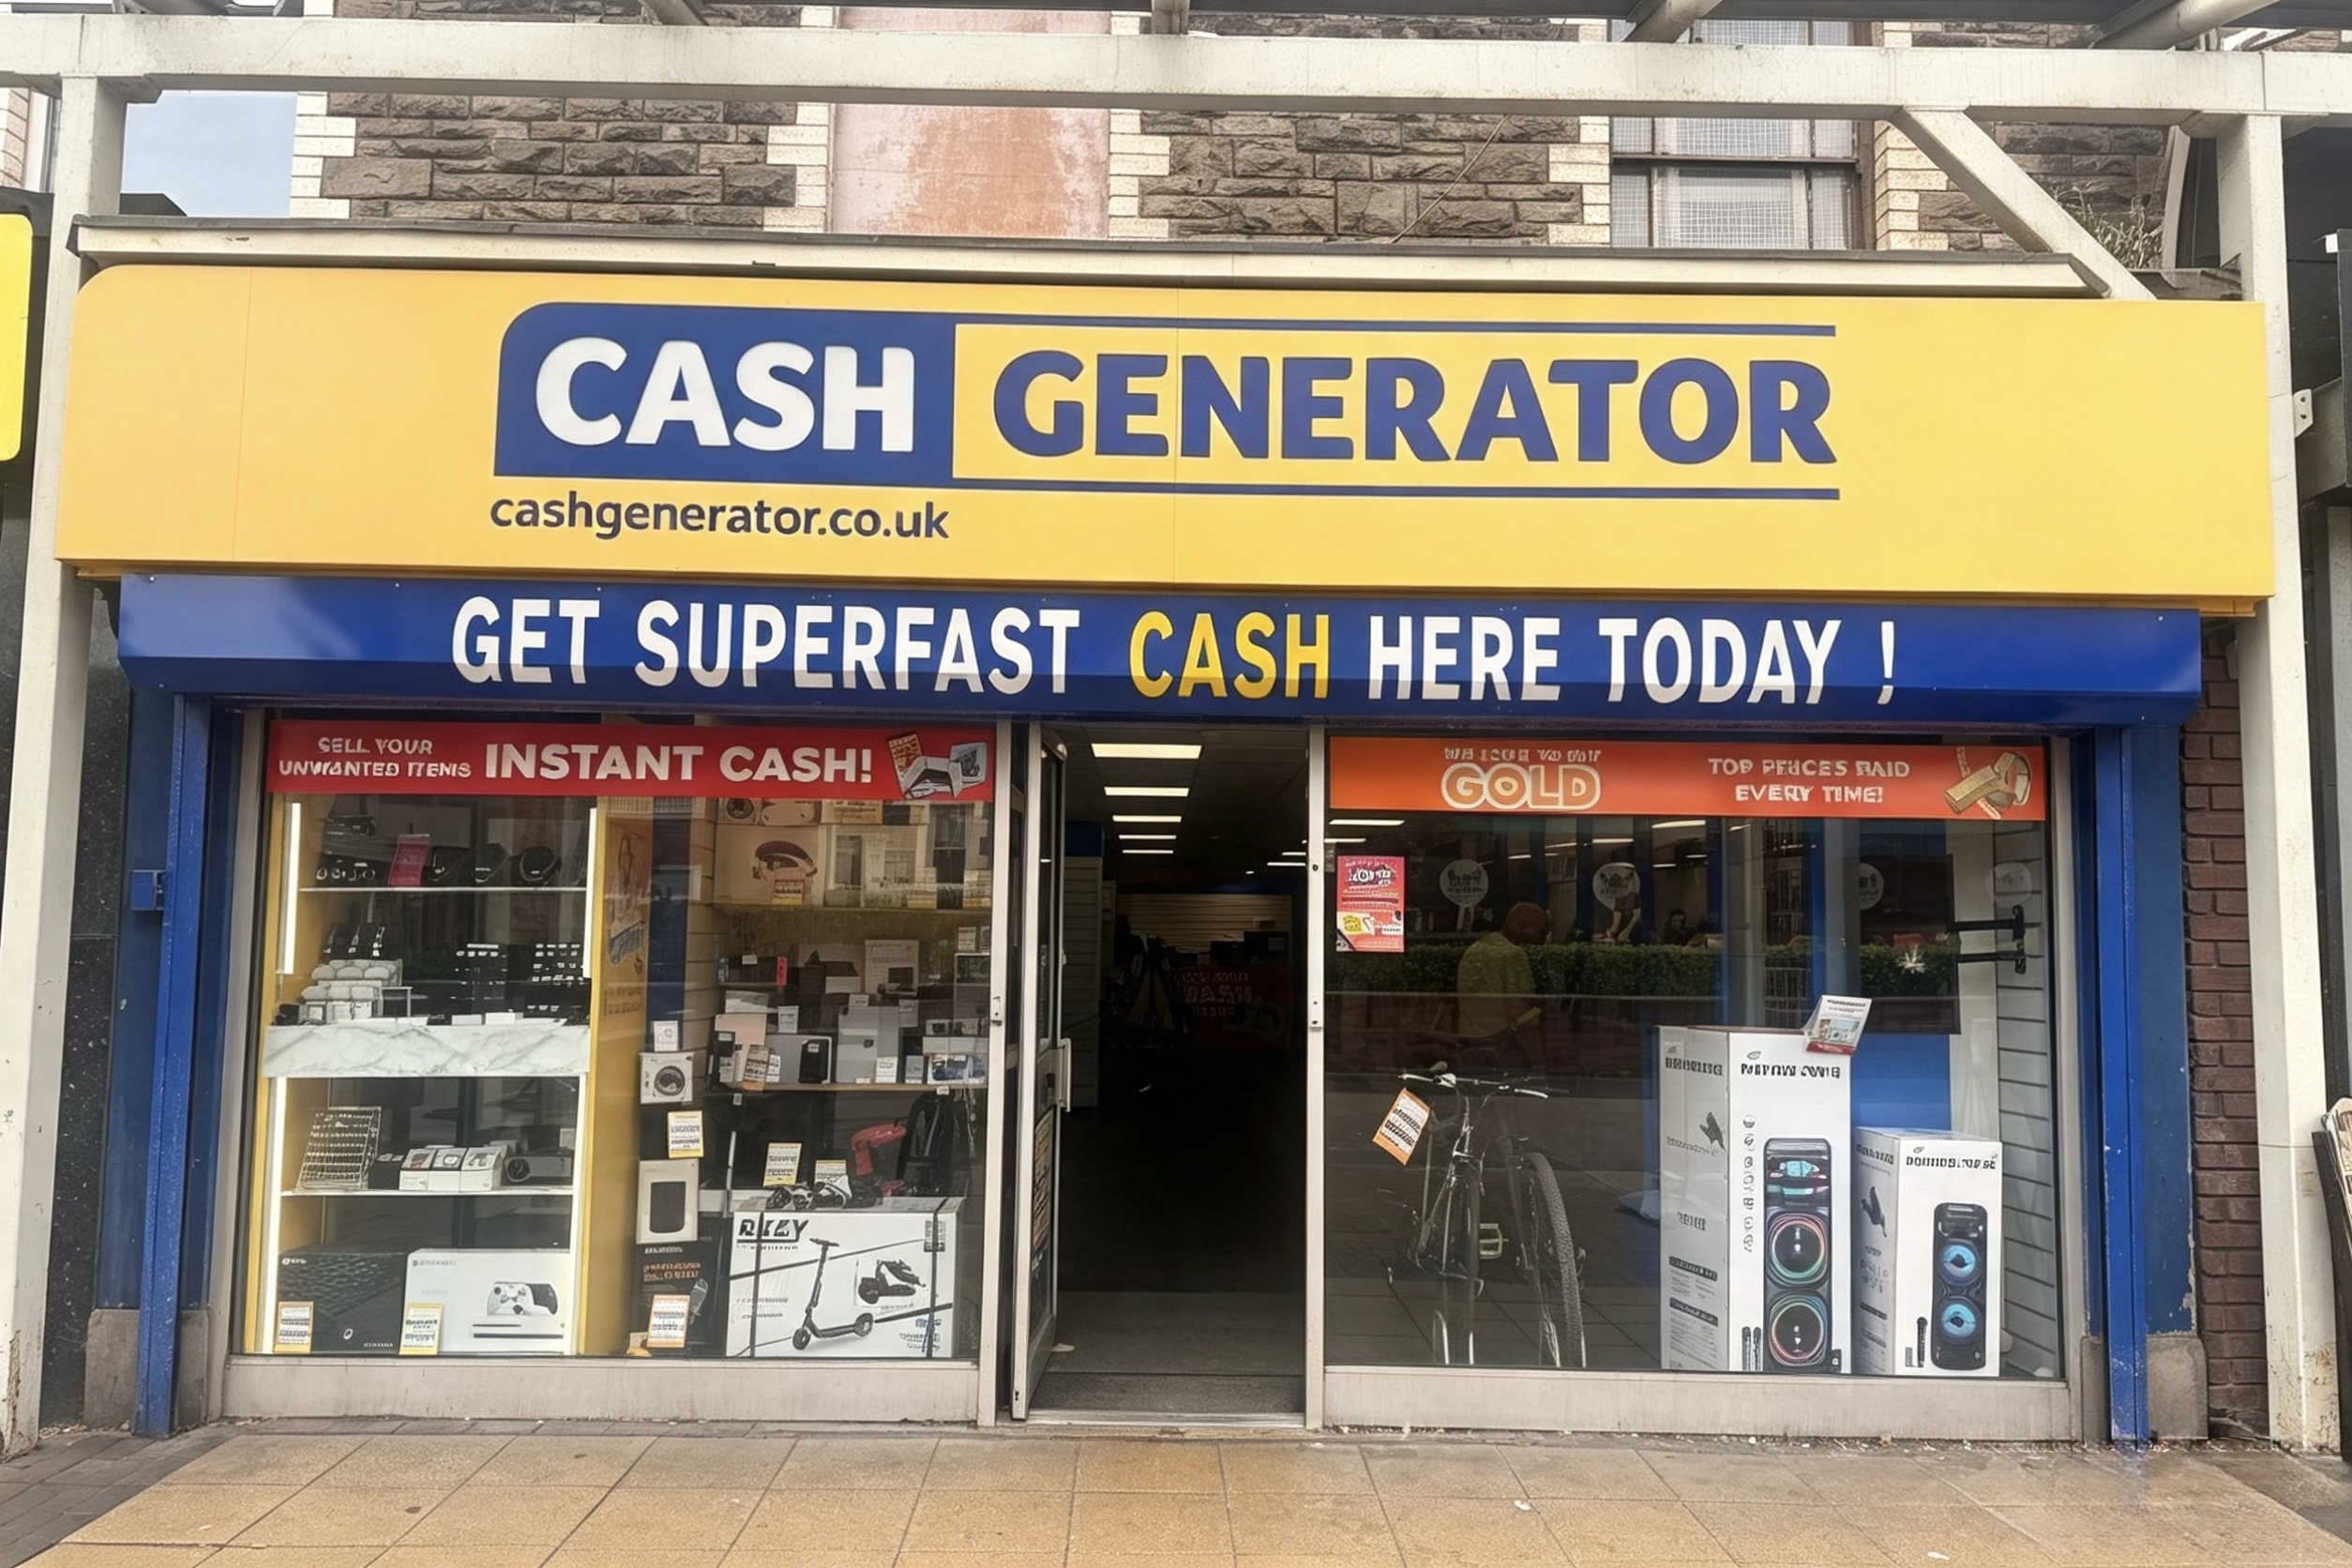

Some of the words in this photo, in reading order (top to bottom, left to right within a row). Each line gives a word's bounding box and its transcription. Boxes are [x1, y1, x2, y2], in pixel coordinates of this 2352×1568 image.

[535, 337, 915, 453] CASH
[994, 351, 1836, 464] GENERATOR
[490, 490, 949, 540] cashgenerator.co.uk
[452, 596, 601, 686] GET
[635, 599, 1081, 695] SUPERFAST
[1128, 610, 1331, 701] CASH
[1368, 615, 1560, 701] HERE
[1598, 617, 1842, 705] TODAY
[1877, 620, 1897, 705] !
[375, 739, 433, 755] YOUR
[486, 744, 702, 781] INSTANT
[719, 746, 872, 783] CASH!
[1440, 762, 1602, 810] GOLD
